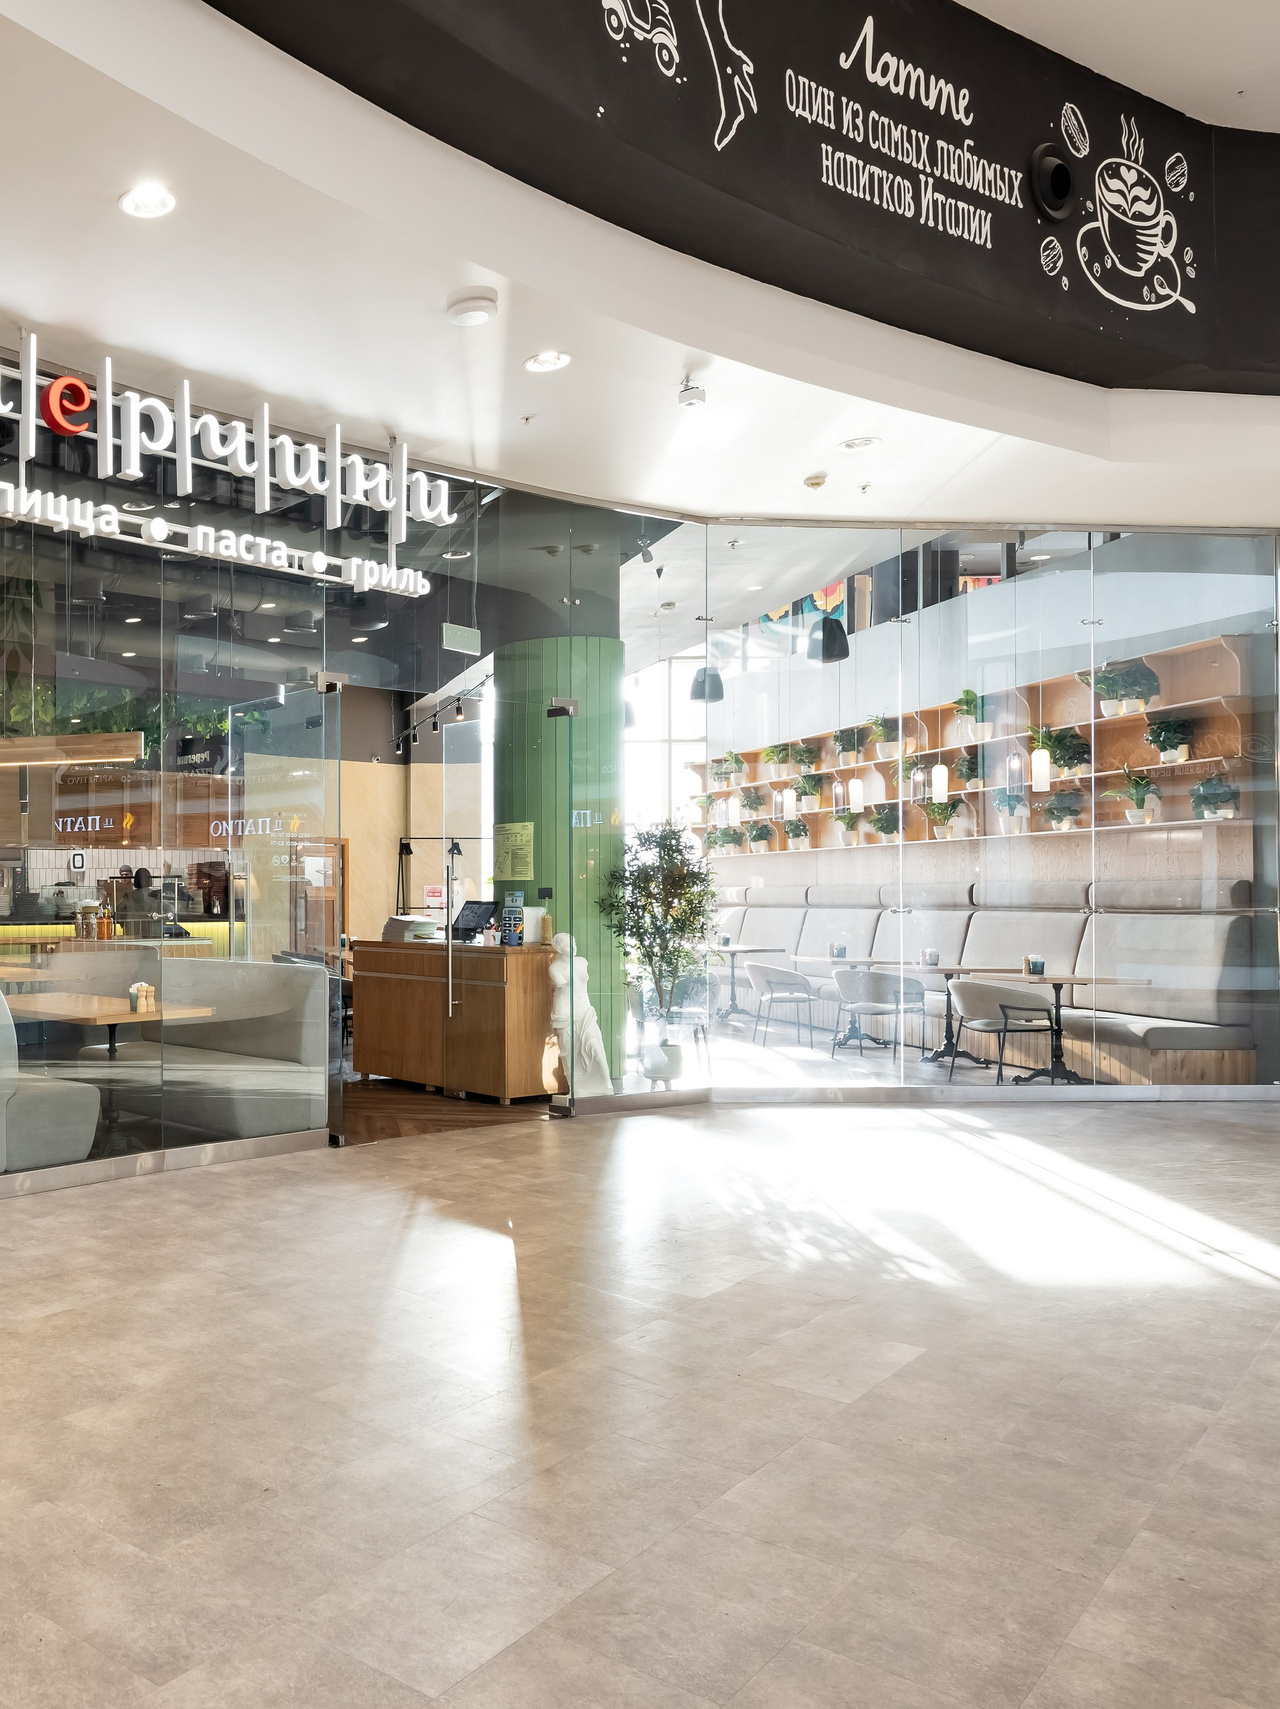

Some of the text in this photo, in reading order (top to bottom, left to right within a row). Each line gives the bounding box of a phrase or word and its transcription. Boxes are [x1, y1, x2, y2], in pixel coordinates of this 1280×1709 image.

[839, 15, 974, 126] Латте
[821, 143, 992, 249] напитков Италии
[841, 96, 864, 143] из
[869, 110, 932, 174] самых
[933, 139, 1024, 209] любимых
[189, 523, 290, 569] паста
[343, 556, 432, 598] гриль
